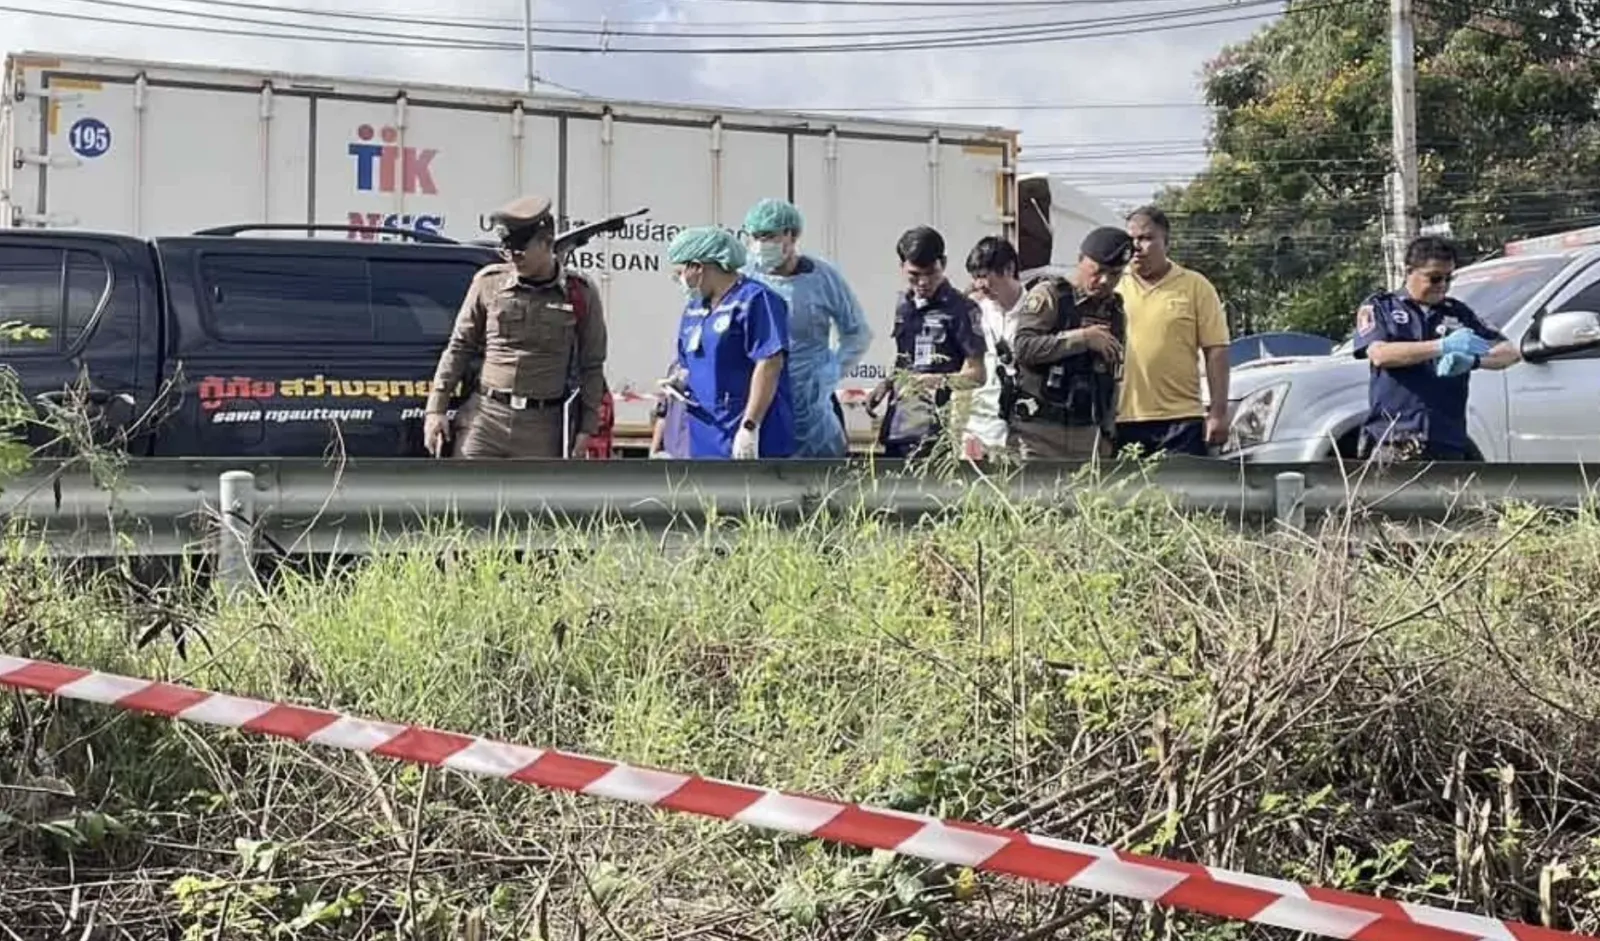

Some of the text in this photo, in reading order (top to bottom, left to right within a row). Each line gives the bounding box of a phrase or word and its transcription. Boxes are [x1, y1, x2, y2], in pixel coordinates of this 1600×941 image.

[74, 125, 107, 151] 195
[280, 375, 462, 401] สว่างอุทย
